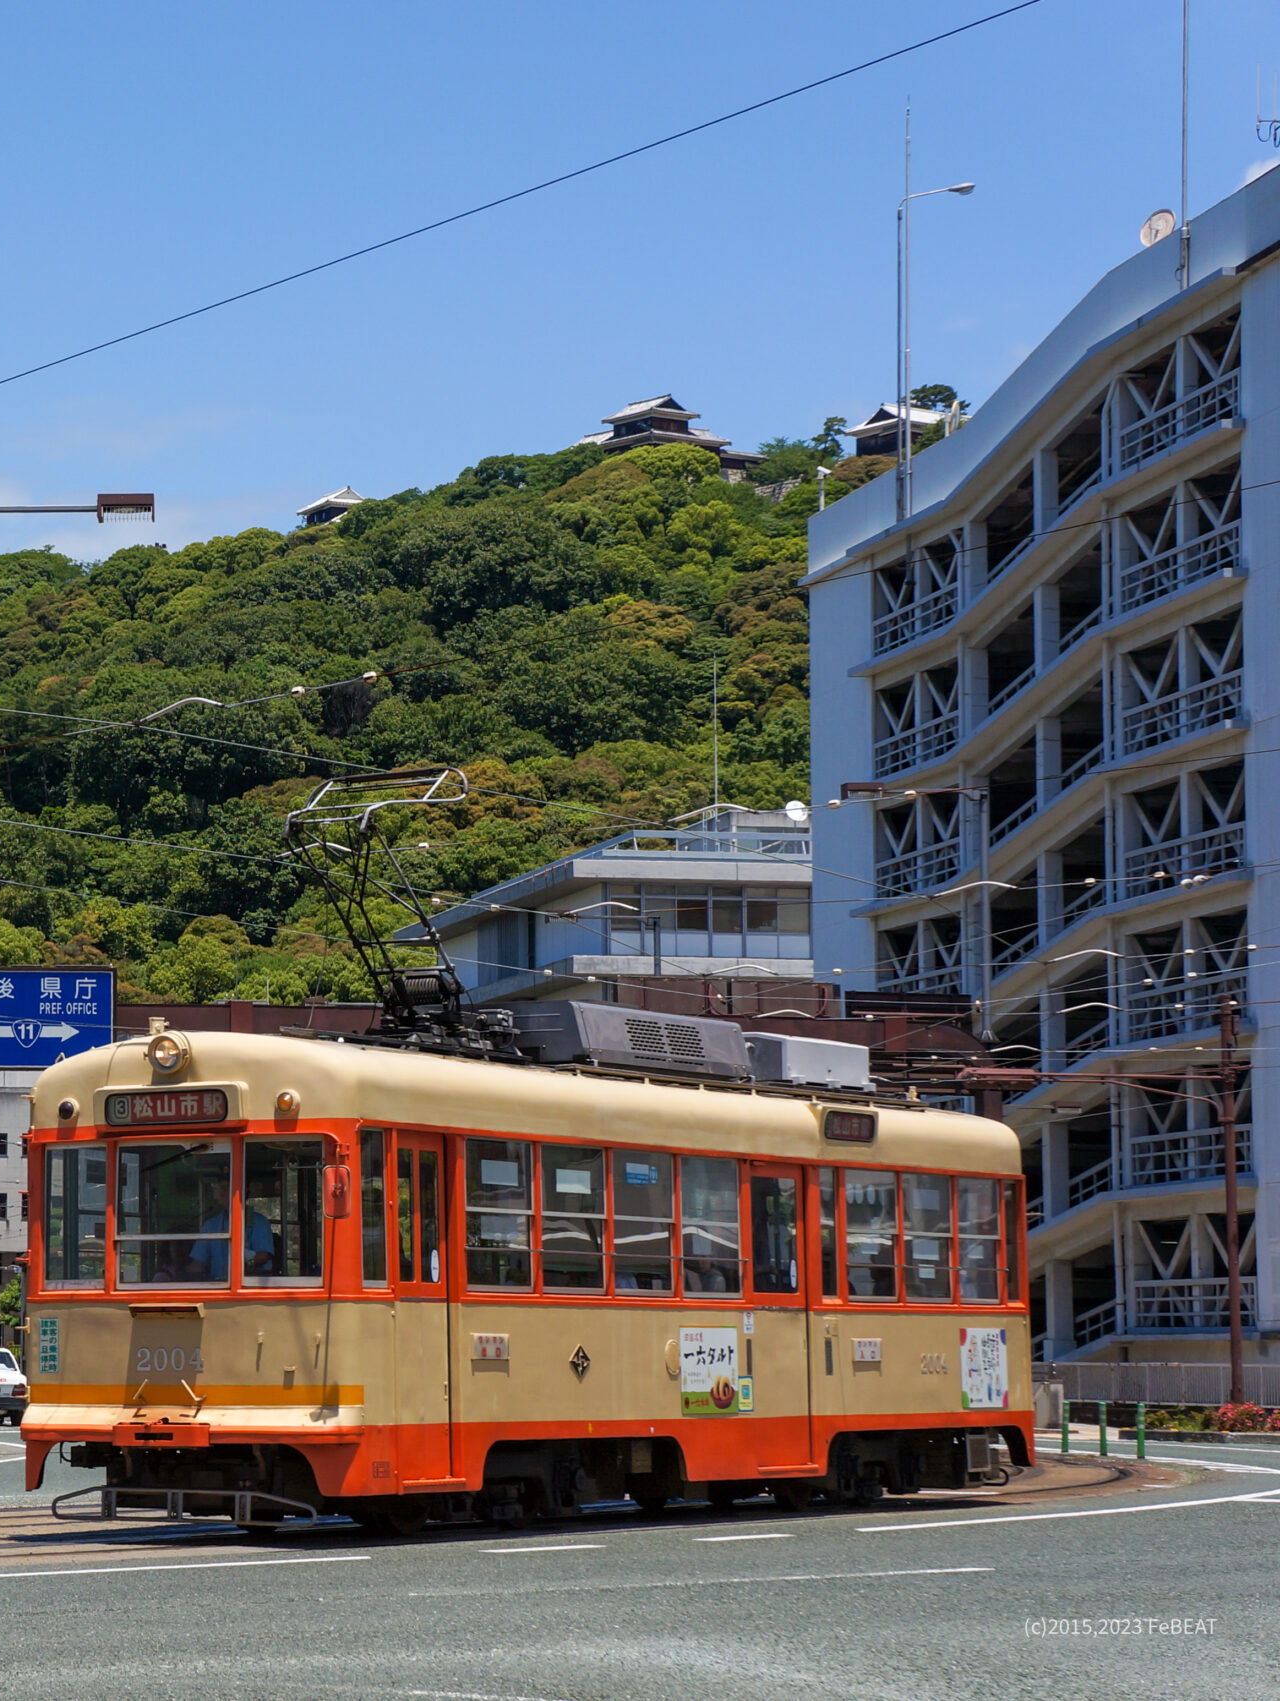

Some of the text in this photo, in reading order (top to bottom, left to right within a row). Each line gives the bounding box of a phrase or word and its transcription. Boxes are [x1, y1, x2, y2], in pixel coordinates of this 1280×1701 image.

[40, 977, 97, 1000] 県庁
[39, 1003, 97, 1015] PREF. OFFICE
[18, 1024, 34, 1040] 11
[133, 1094, 224, 1118] 松山市駅
[136, 1347, 204, 1372] 2004
